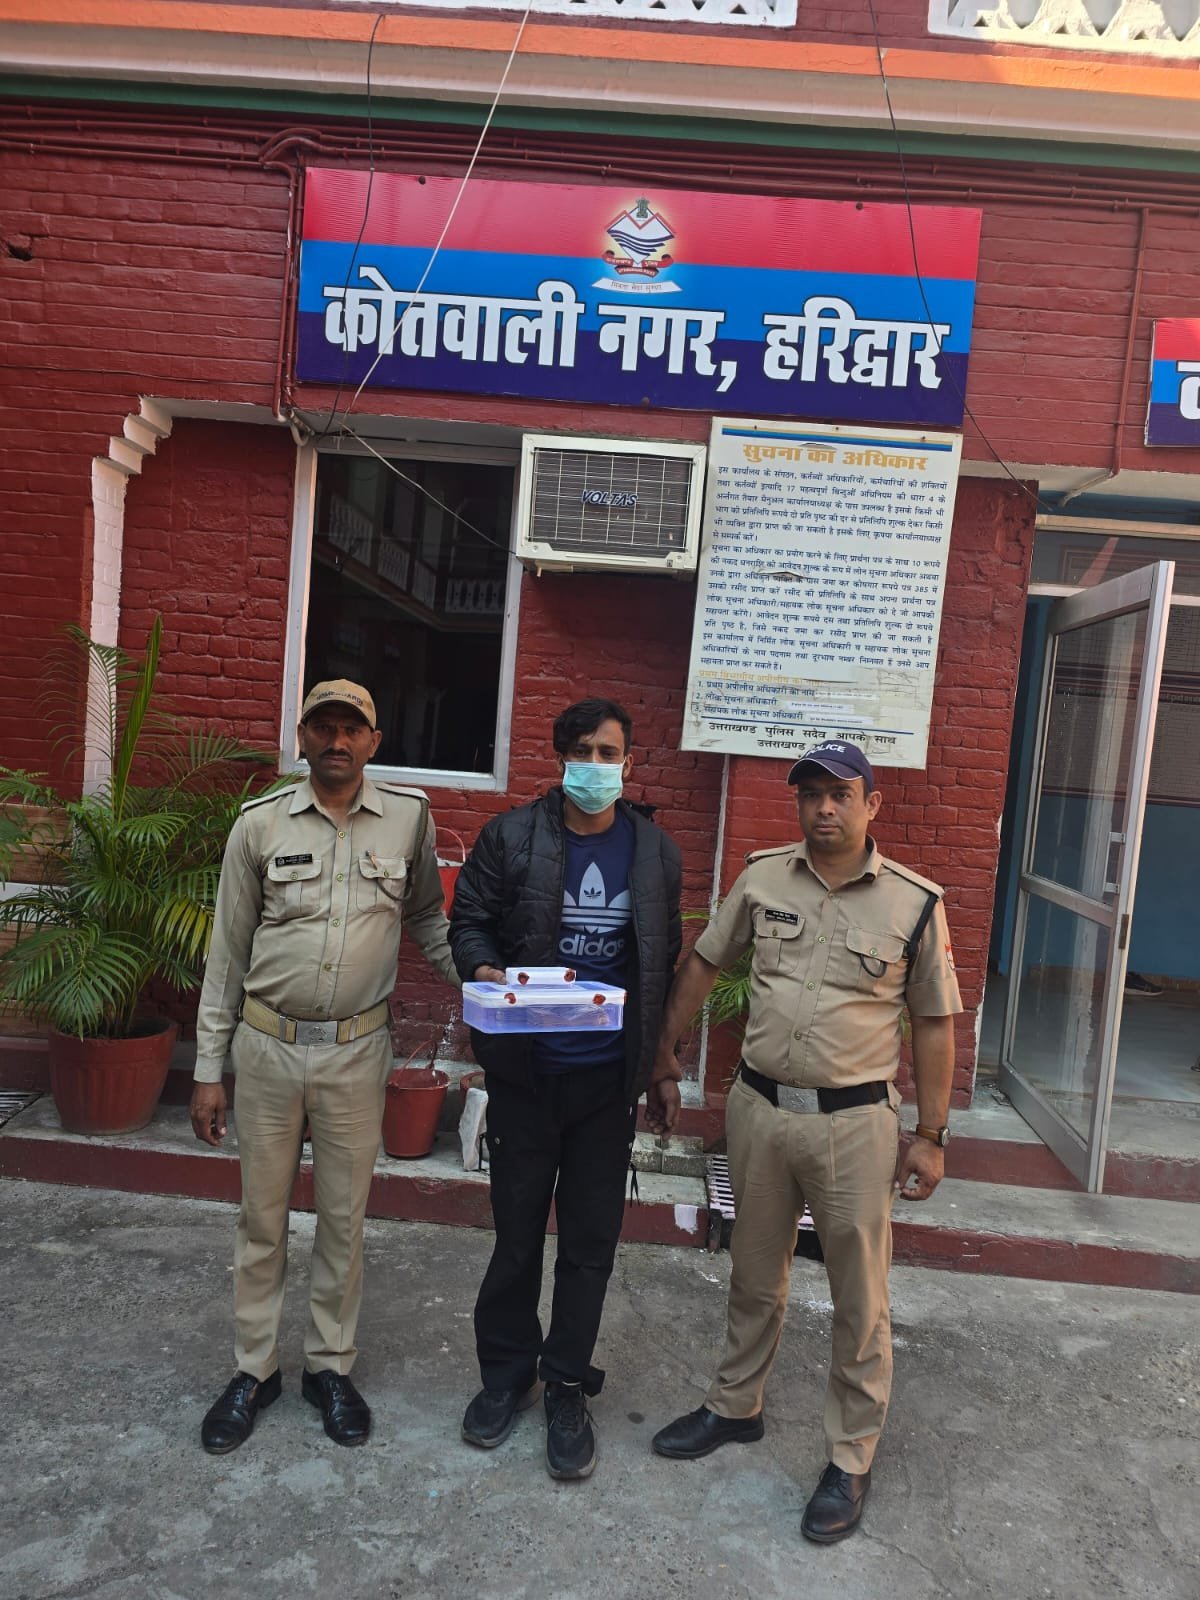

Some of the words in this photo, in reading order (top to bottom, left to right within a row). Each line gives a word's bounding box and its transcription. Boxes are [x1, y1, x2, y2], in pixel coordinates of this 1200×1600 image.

[323, 266, 585, 368] कोतवाली
[597, 303, 737, 392] नगर,
[761, 297, 950, 389] हरिद्वार
[582, 490, 637, 506] VOLTAS
[912, 558, 920, 566] 10
[708, 722, 757, 733] उत्तराखण्ड
[765, 724, 794, 738] पुलिस
[835, 729, 867, 741] आपके
[874, 735, 896, 744] साथ
[757, 739, 805, 750] उत्तराखण्ड
